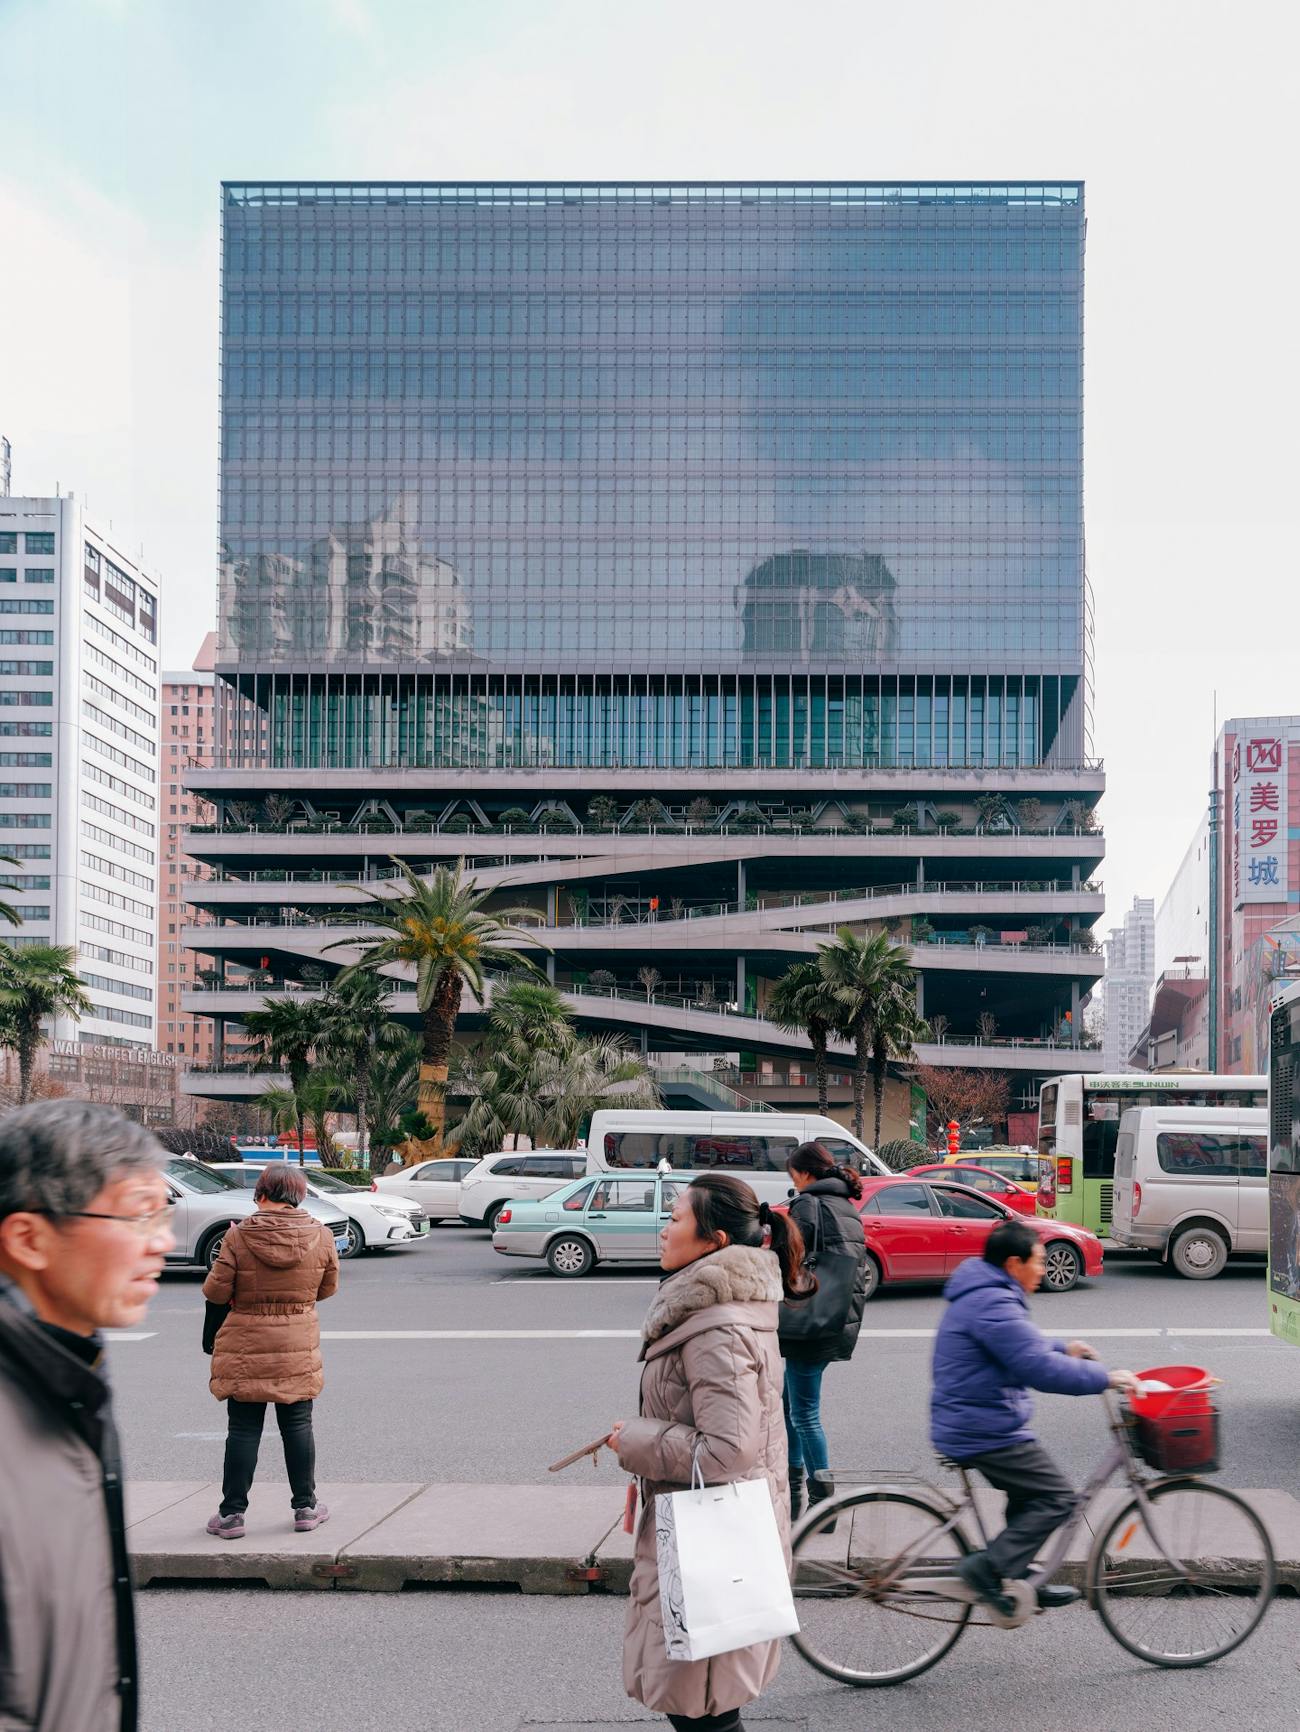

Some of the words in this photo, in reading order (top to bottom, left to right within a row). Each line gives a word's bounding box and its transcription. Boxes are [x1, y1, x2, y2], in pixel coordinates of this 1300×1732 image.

[1248, 782, 1279, 886] 美罗城
[53, 1039, 83, 1055] WALL
[94, 1044, 134, 1062] STREET
[137, 1049, 178, 1067] ENGLISH
[1090, 1081, 1132, 1089] 申沃客车
